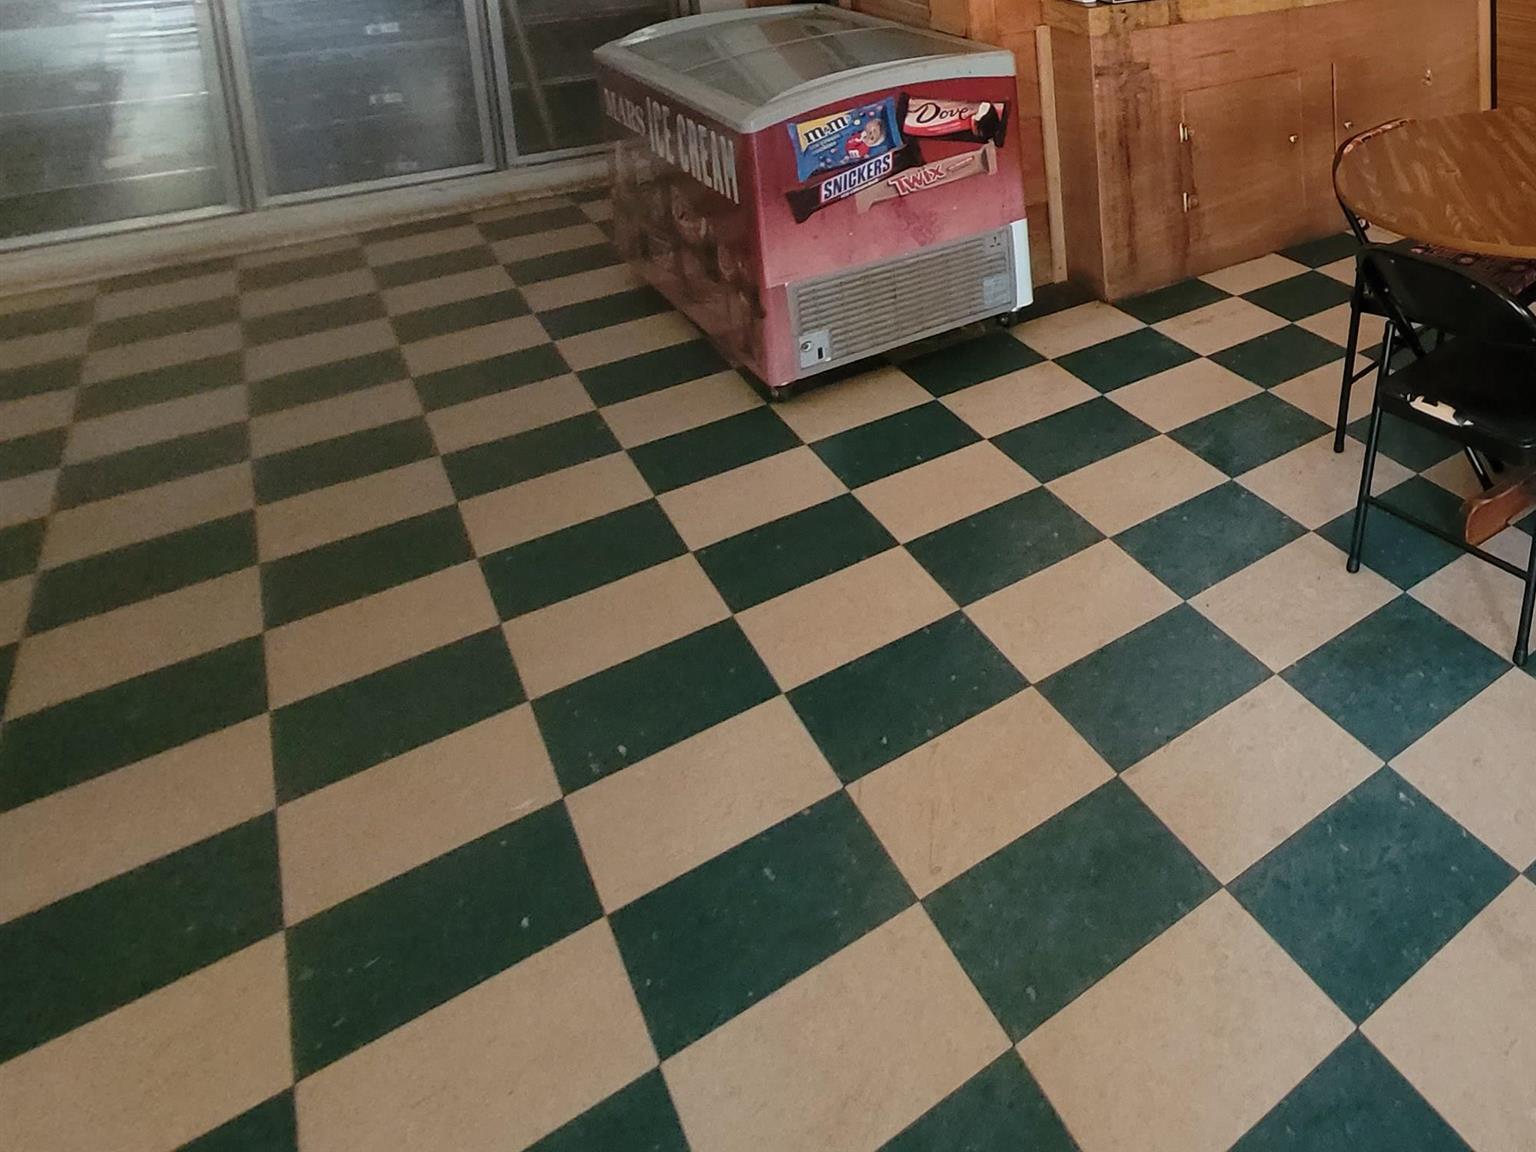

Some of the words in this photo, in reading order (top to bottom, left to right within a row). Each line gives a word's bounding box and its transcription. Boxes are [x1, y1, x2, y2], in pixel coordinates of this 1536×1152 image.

[646, 96, 675, 165] ICE
[676, 114, 740, 204] CREAM
[823, 156, 891, 199] SNICKERS
